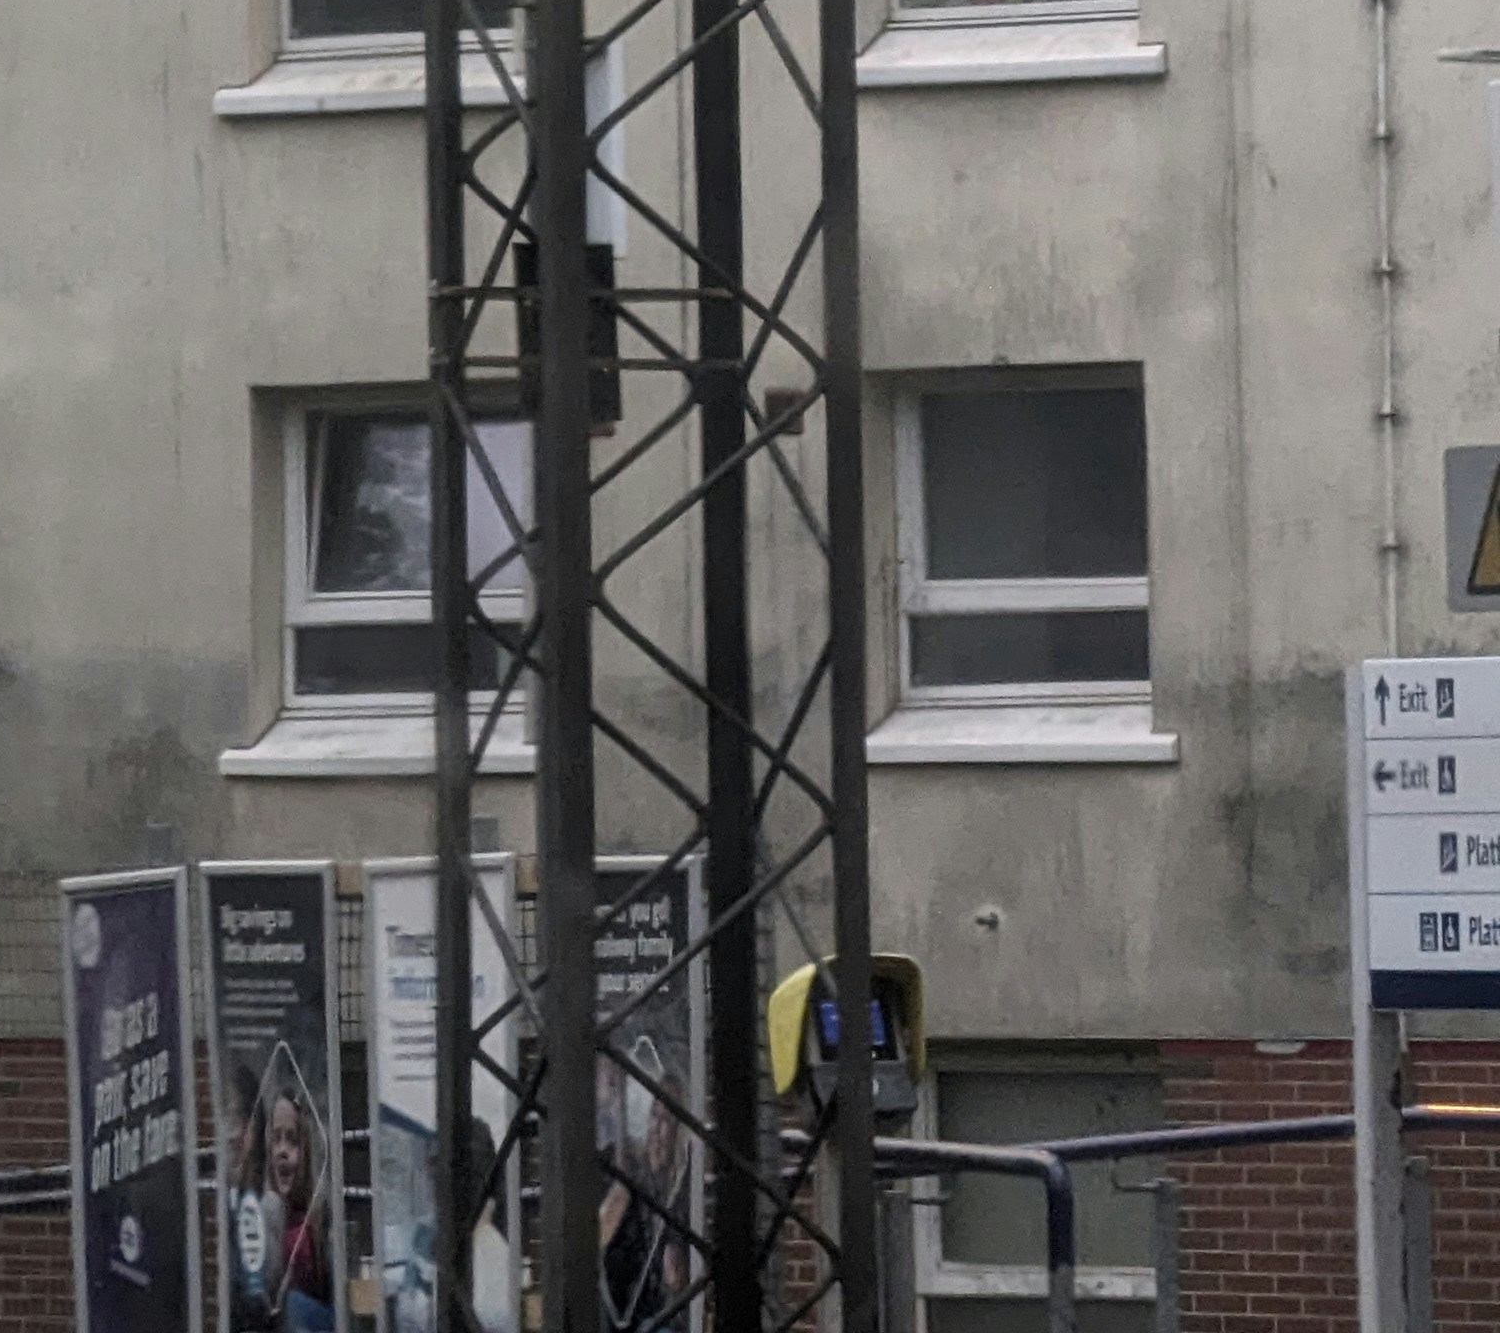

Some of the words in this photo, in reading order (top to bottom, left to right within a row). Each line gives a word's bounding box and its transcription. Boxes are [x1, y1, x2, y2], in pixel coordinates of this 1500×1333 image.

[1399, 683, 1429, 713] Exit
[1400, 760, 1429, 790] Exit
[1466, 834, 1500, 865] Plat
[1469, 915, 1500, 946] Plat
